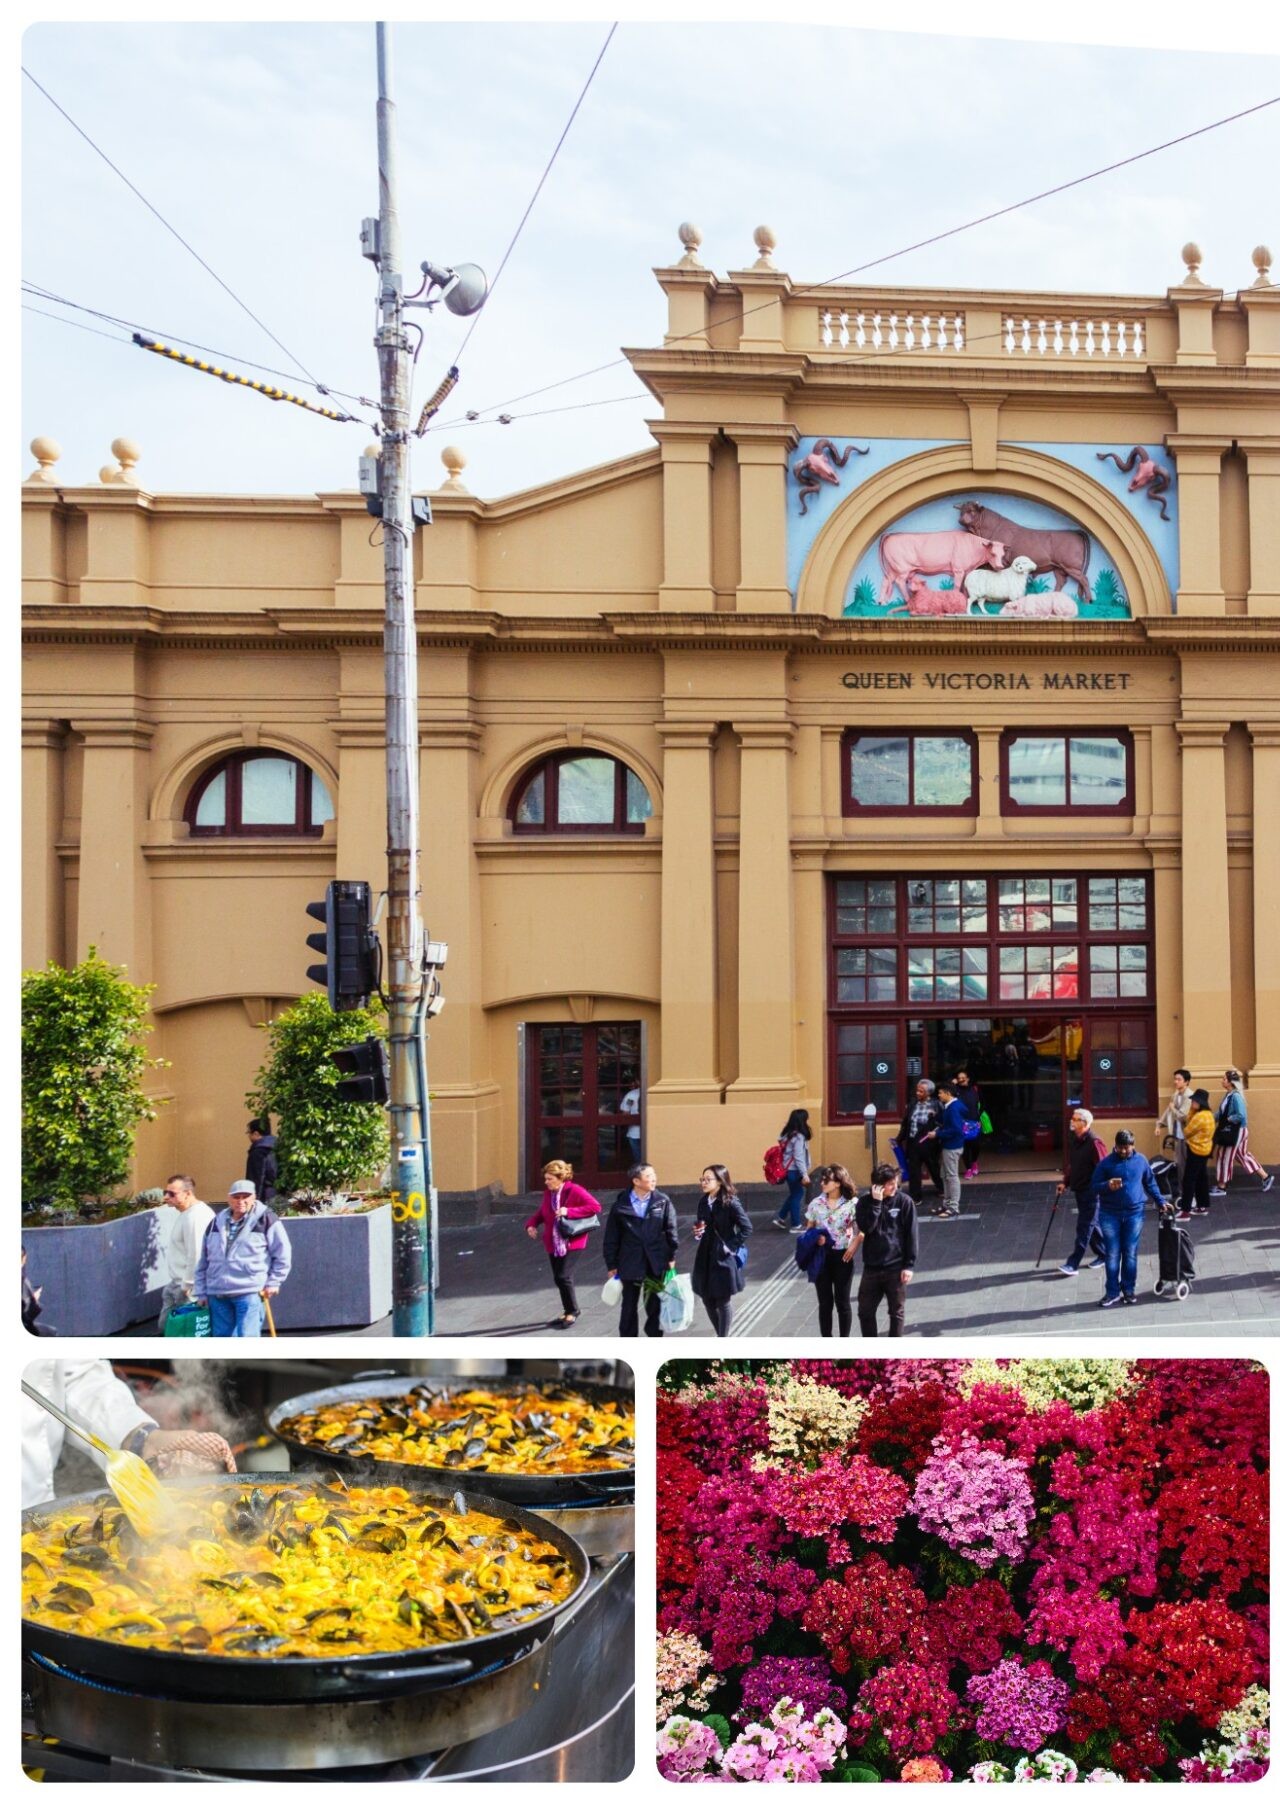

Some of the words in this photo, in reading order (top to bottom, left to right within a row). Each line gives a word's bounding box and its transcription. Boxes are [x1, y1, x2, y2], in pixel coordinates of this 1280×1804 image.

[842, 672, 912, 690] QUEEN
[925, 673, 1031, 690] VICTORIA
[1043, 673, 1131, 691] MARKET
[390, 1191, 426, 1222] 50
[196, 1315, 209, 1323] ba
